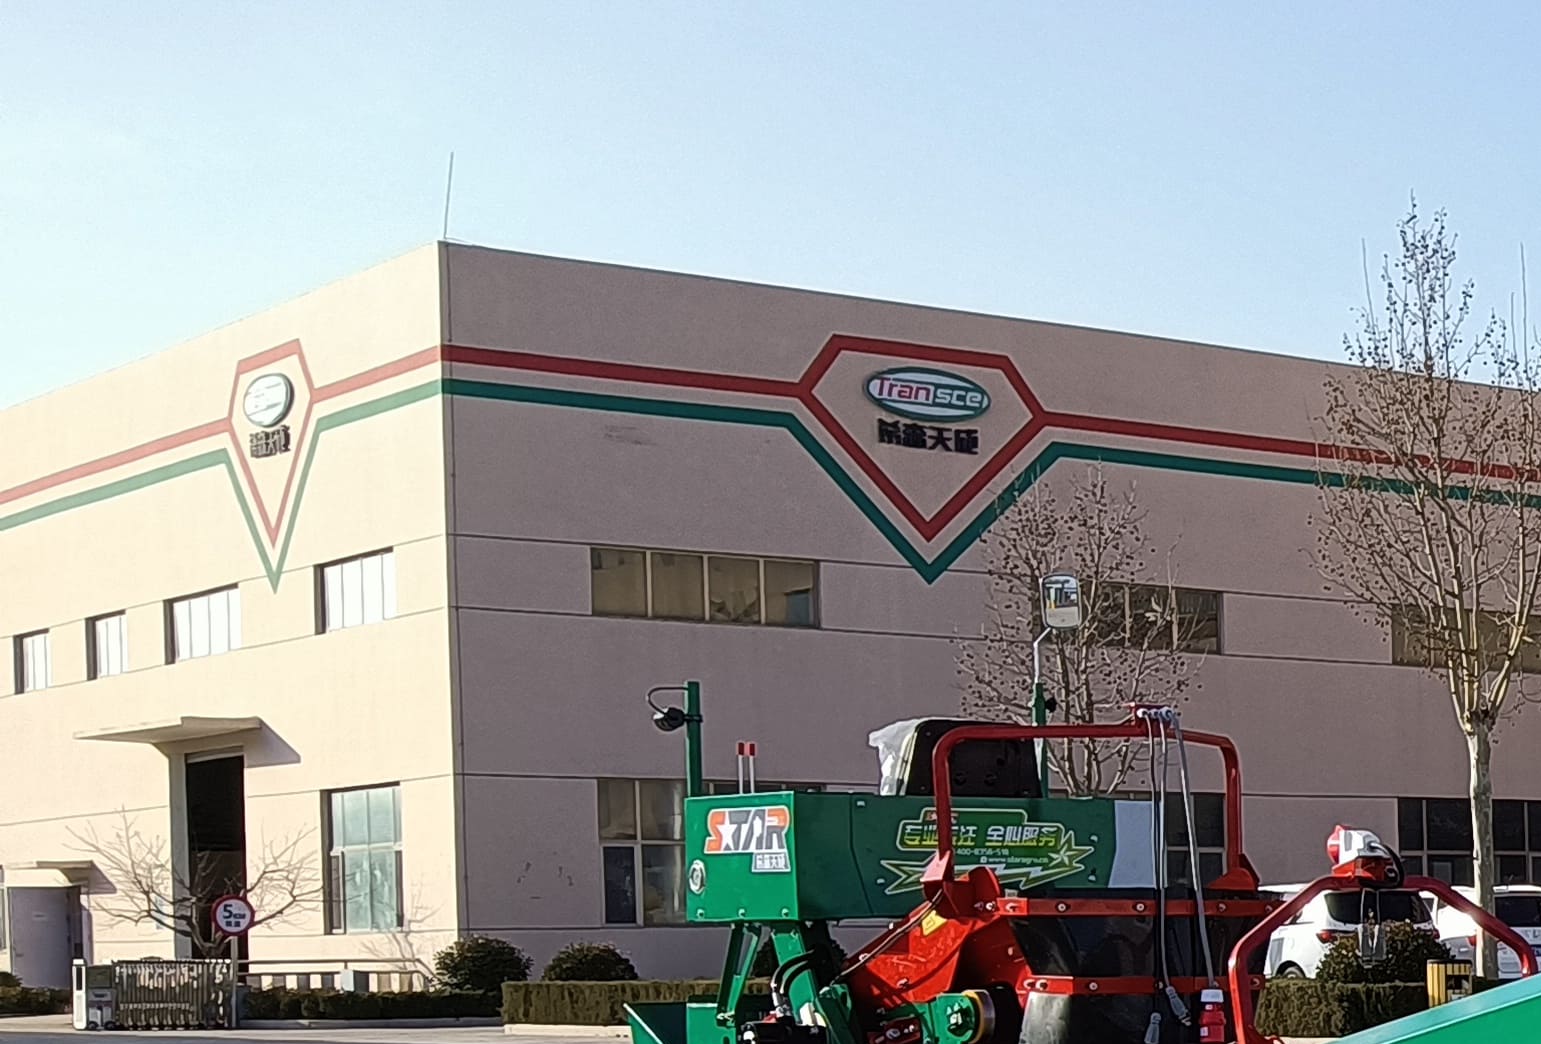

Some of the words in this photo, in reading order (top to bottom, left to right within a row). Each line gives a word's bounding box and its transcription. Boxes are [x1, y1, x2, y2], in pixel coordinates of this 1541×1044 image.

[878, 377, 982, 407] Transce
[705, 807, 789, 853] STAR
[985, 826, 1058, 847] 全心服务
